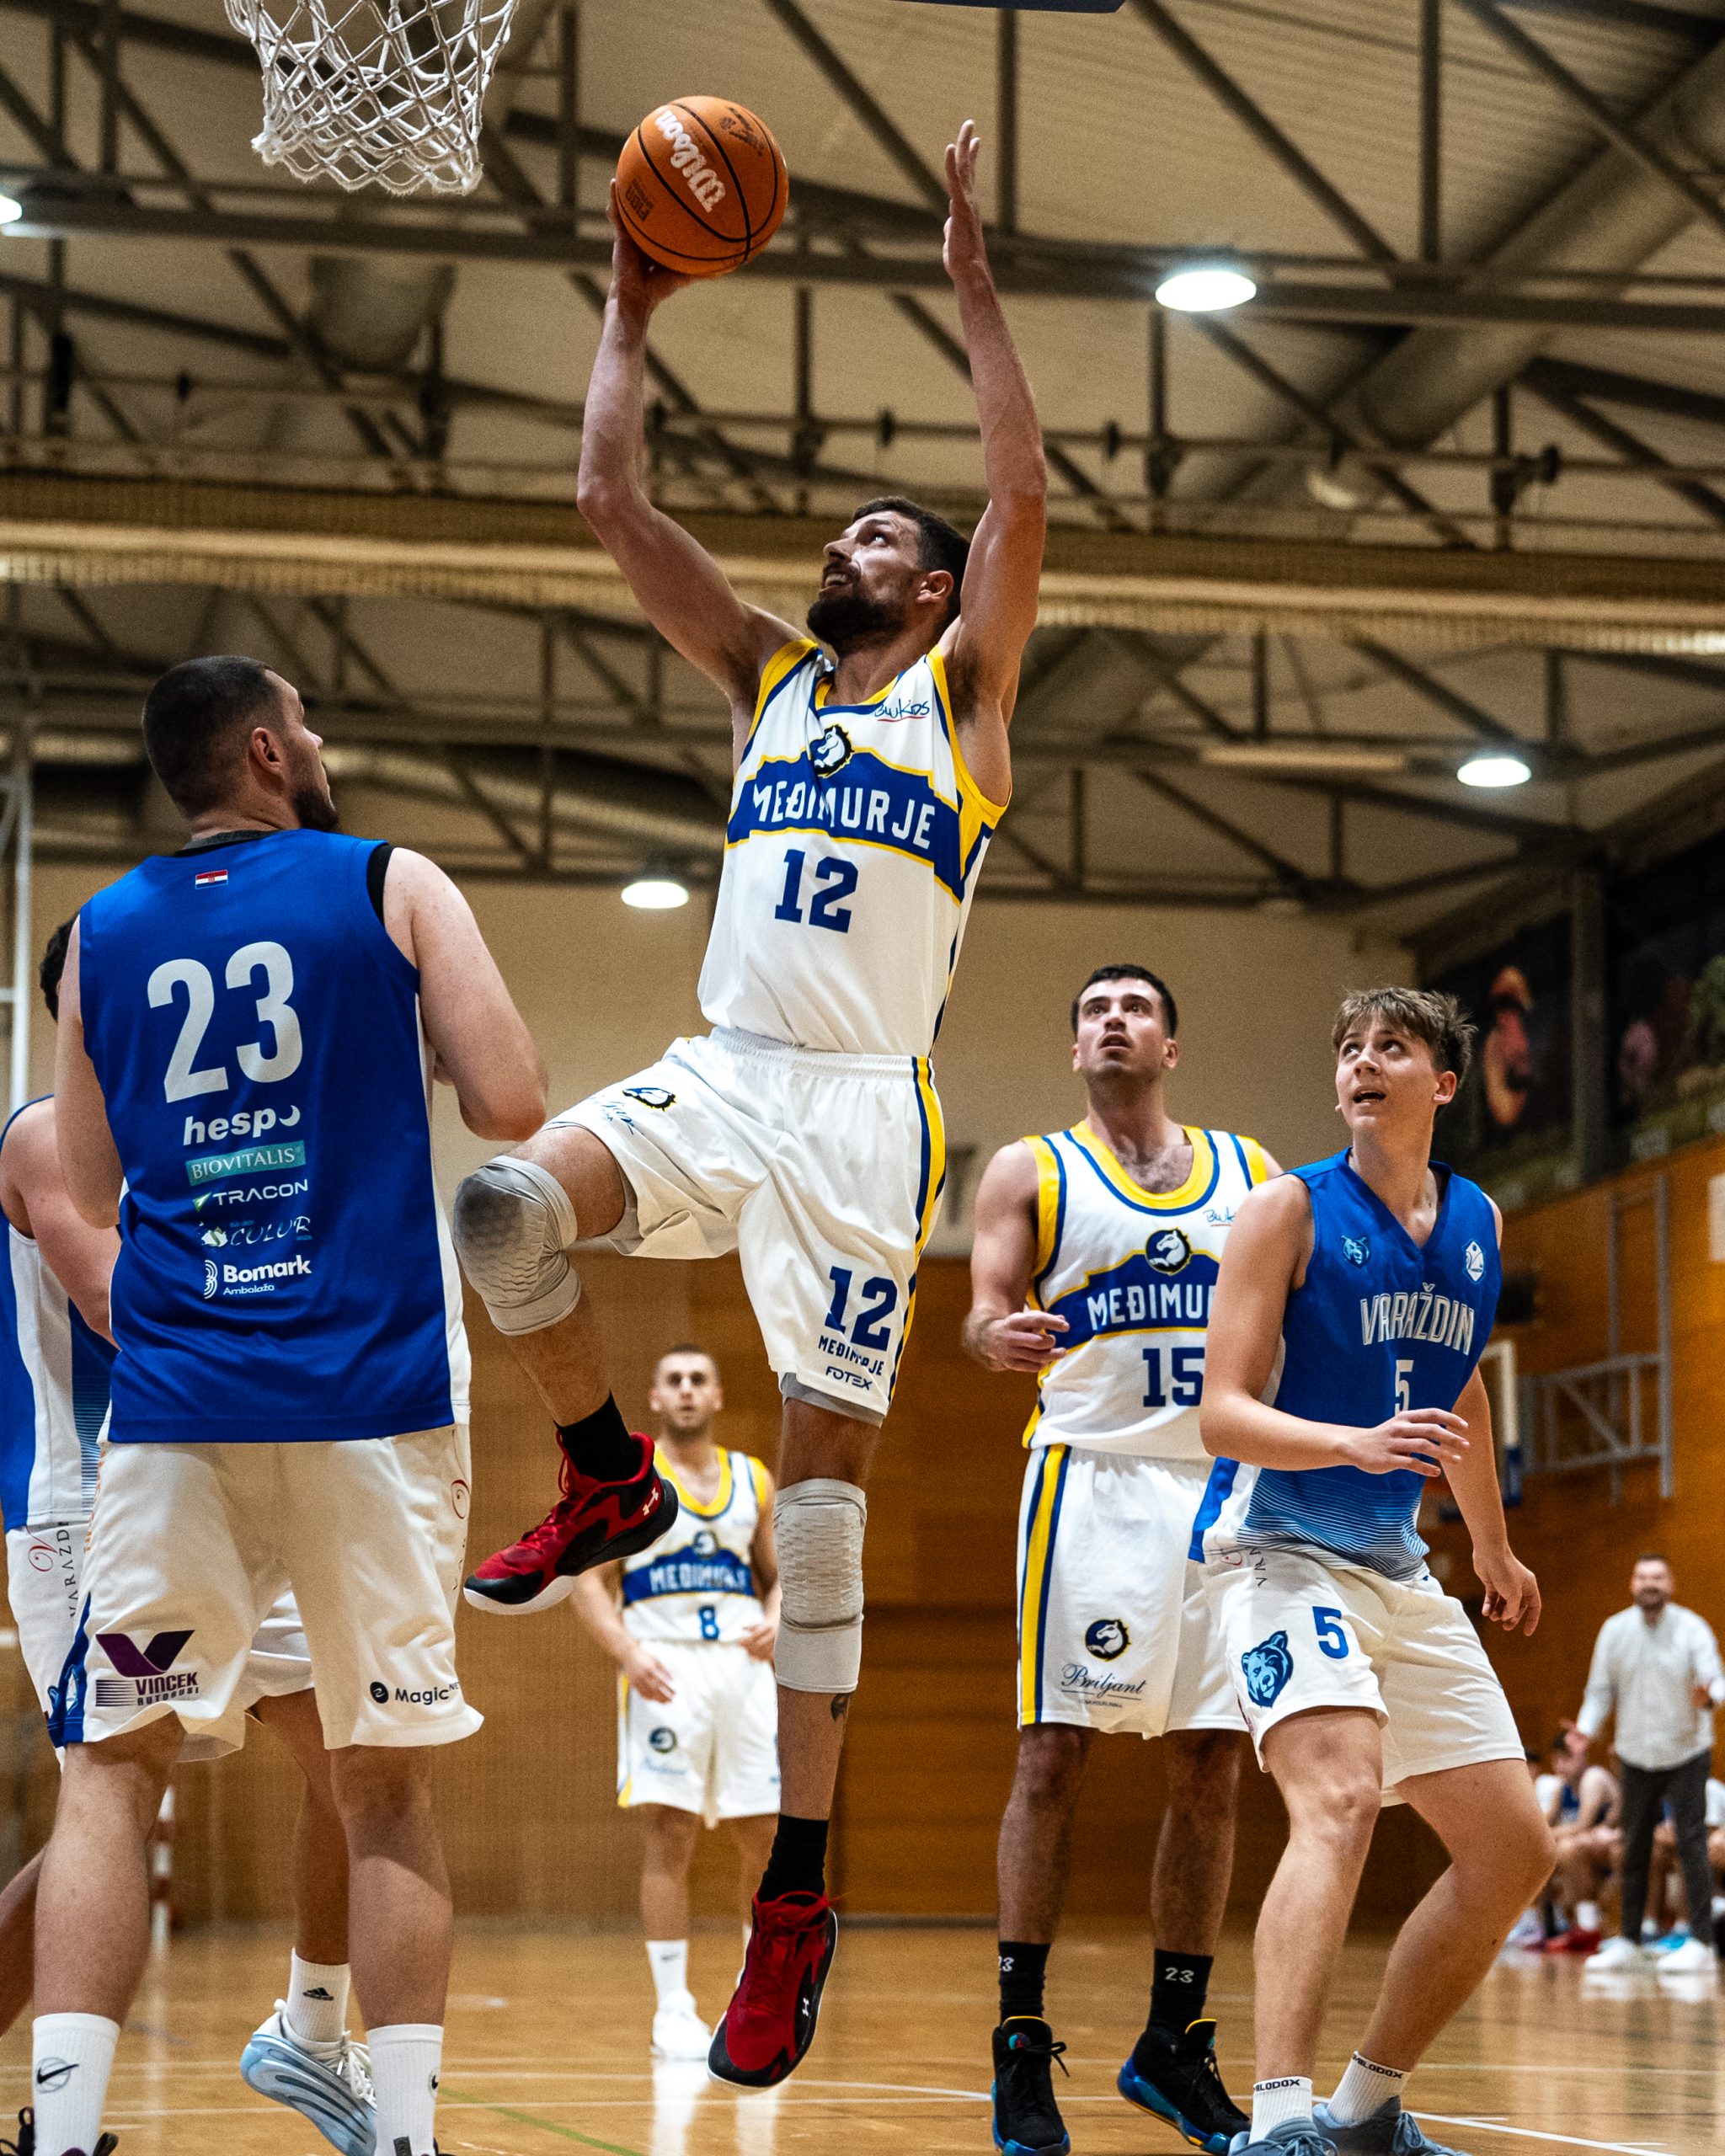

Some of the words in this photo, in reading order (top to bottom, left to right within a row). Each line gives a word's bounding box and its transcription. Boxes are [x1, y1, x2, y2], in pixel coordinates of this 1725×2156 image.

[654, 109, 726, 214] Wilson
[774, 849, 858, 934] 12
[147, 941, 302, 1103] 23
[212, 1179, 308, 1206] TRACON
[223, 1254, 312, 1283] Bomark
[223, 1283, 275, 1295] Ambalaža
[825, 1265, 898, 1351] 12
[1360, 1282, 1475, 1355] VARAŽDIN
[825, 1366, 873, 1390] FOTEX
[1142, 1347, 1205, 1408] 15
[1394, 1359, 1414, 1416] 5
[698, 1604, 719, 1641] 8
[1311, 1605, 1349, 1660] 5
[135, 1672, 199, 1696] VINCEK
[395, 1685, 450, 1706] Magic
[1061, 1663, 1147, 1699] Briljant
[1165, 1967, 1195, 1983] 23
